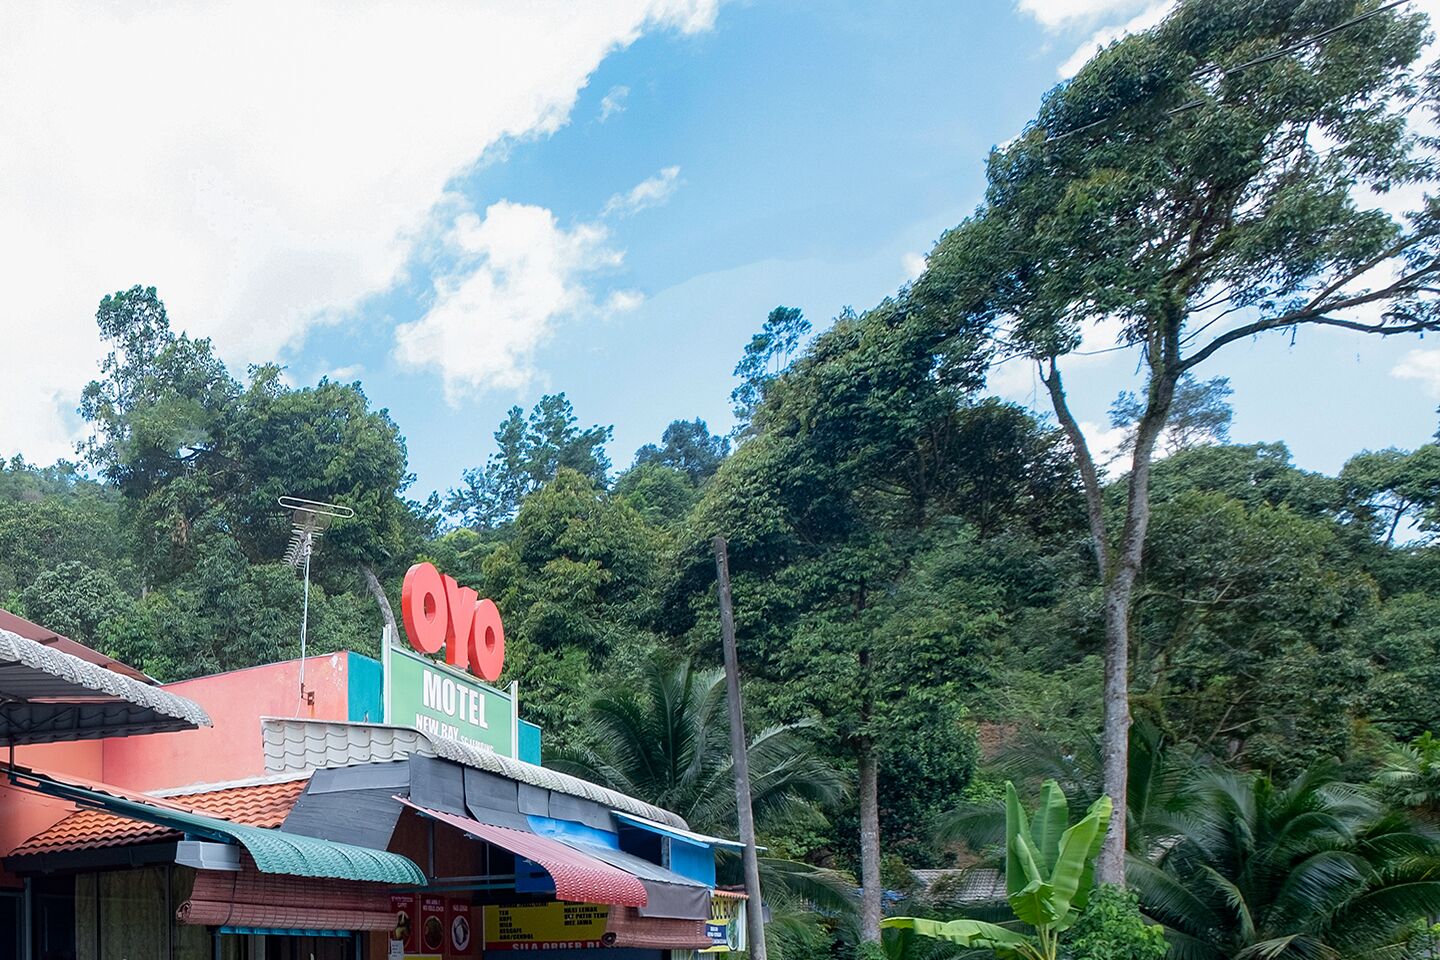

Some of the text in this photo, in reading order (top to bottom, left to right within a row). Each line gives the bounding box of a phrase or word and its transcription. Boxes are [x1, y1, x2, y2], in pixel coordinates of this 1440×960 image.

[402, 562, 505, 682] OYO
[415, 713, 439, 736] NEW
[441, 721, 460, 741] BAY
[423, 669, 488, 729] MOTEL
